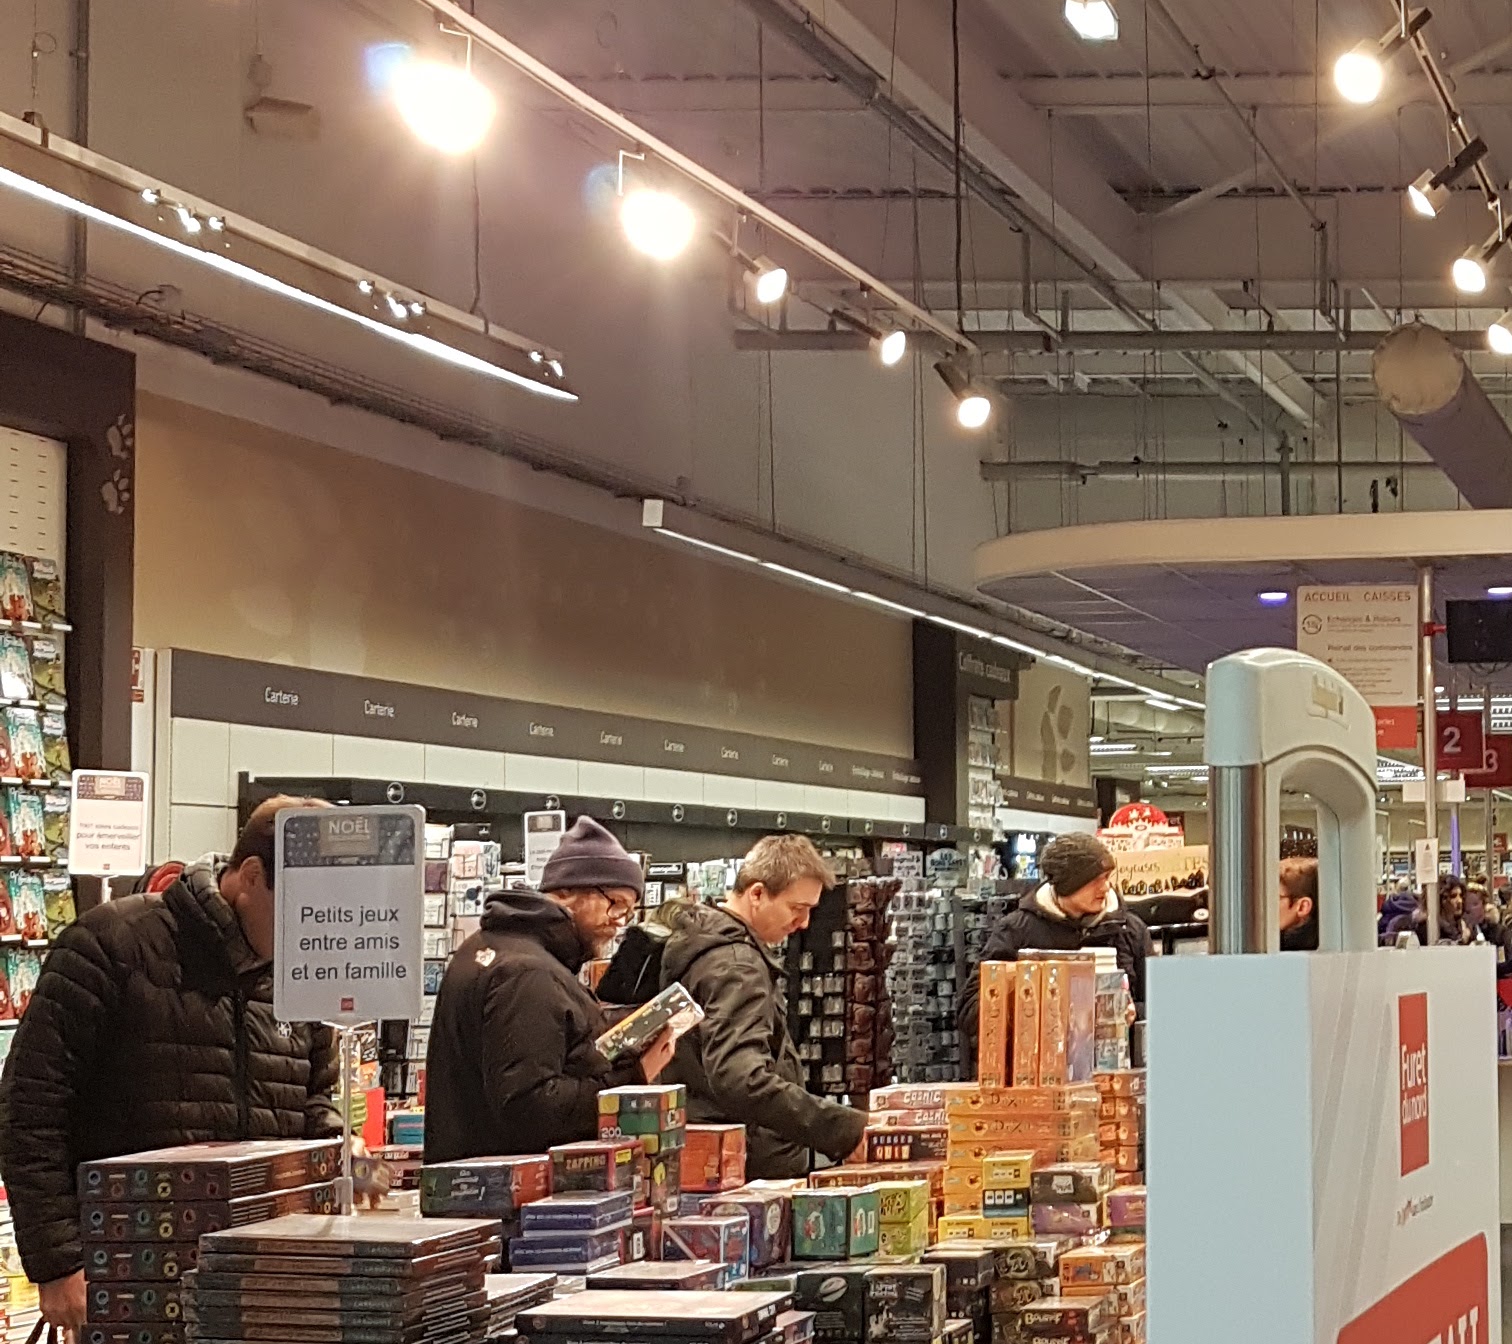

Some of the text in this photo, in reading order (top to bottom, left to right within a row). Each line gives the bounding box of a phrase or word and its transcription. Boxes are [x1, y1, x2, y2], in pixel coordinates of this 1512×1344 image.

[1304, 591, 1411, 602] ACCUEIL CAISSES
[265, 687, 299, 705] Carterie
[364, 700, 394, 717] Carterie
[452, 712, 478, 728] Carterie
[1443, 727, 1461, 753] 2
[1485, 749, 1498, 773] 3
[328, 816, 370, 834] NOËL
[301, 906, 399, 926] Petits jeux
[299, 933, 400, 951] entre amis
[291, 962, 407, 980] et en famille
[1401, 1042, 1427, 1091] Furet
[601, 1126, 621, 1138] 200
